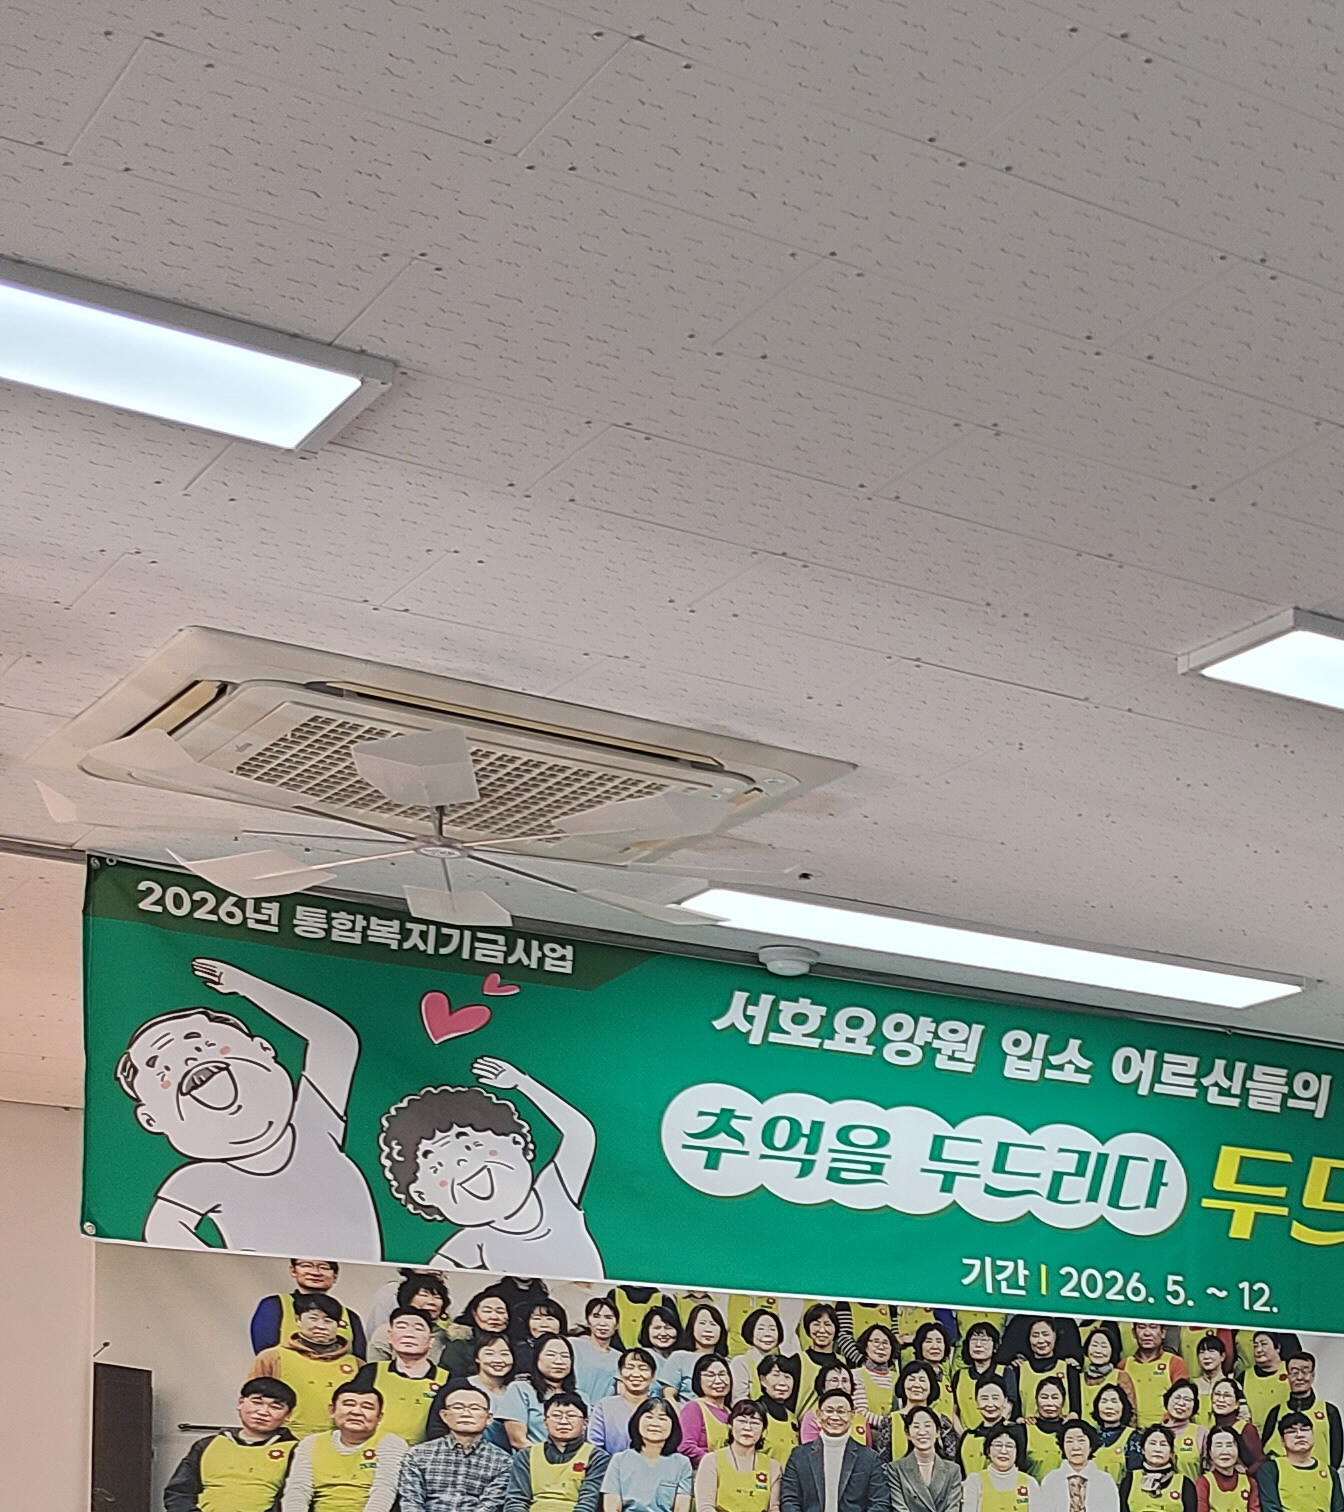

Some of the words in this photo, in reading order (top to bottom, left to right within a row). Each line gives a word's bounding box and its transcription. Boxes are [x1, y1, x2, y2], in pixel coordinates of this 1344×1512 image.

[137, 881, 280, 932] 2026년
[293, 906, 574, 974] 통합복지기금사업
[712, 990, 985, 1074] 서호요양원
[1002, 1027, 1095, 1085] 입소
[1112, 1046, 1331, 1119] 어르신들의
[682, 1107, 893, 1186] 추억을
[921, 1133, 1168, 1211] 두드리다
[961, 1257, 1030, 1297] 기간
[1060, 1266, 1154, 1304] 2026.
[1167, 1275, 1195, 1306] 5.
[1239, 1281, 1279, 1313] 12.
